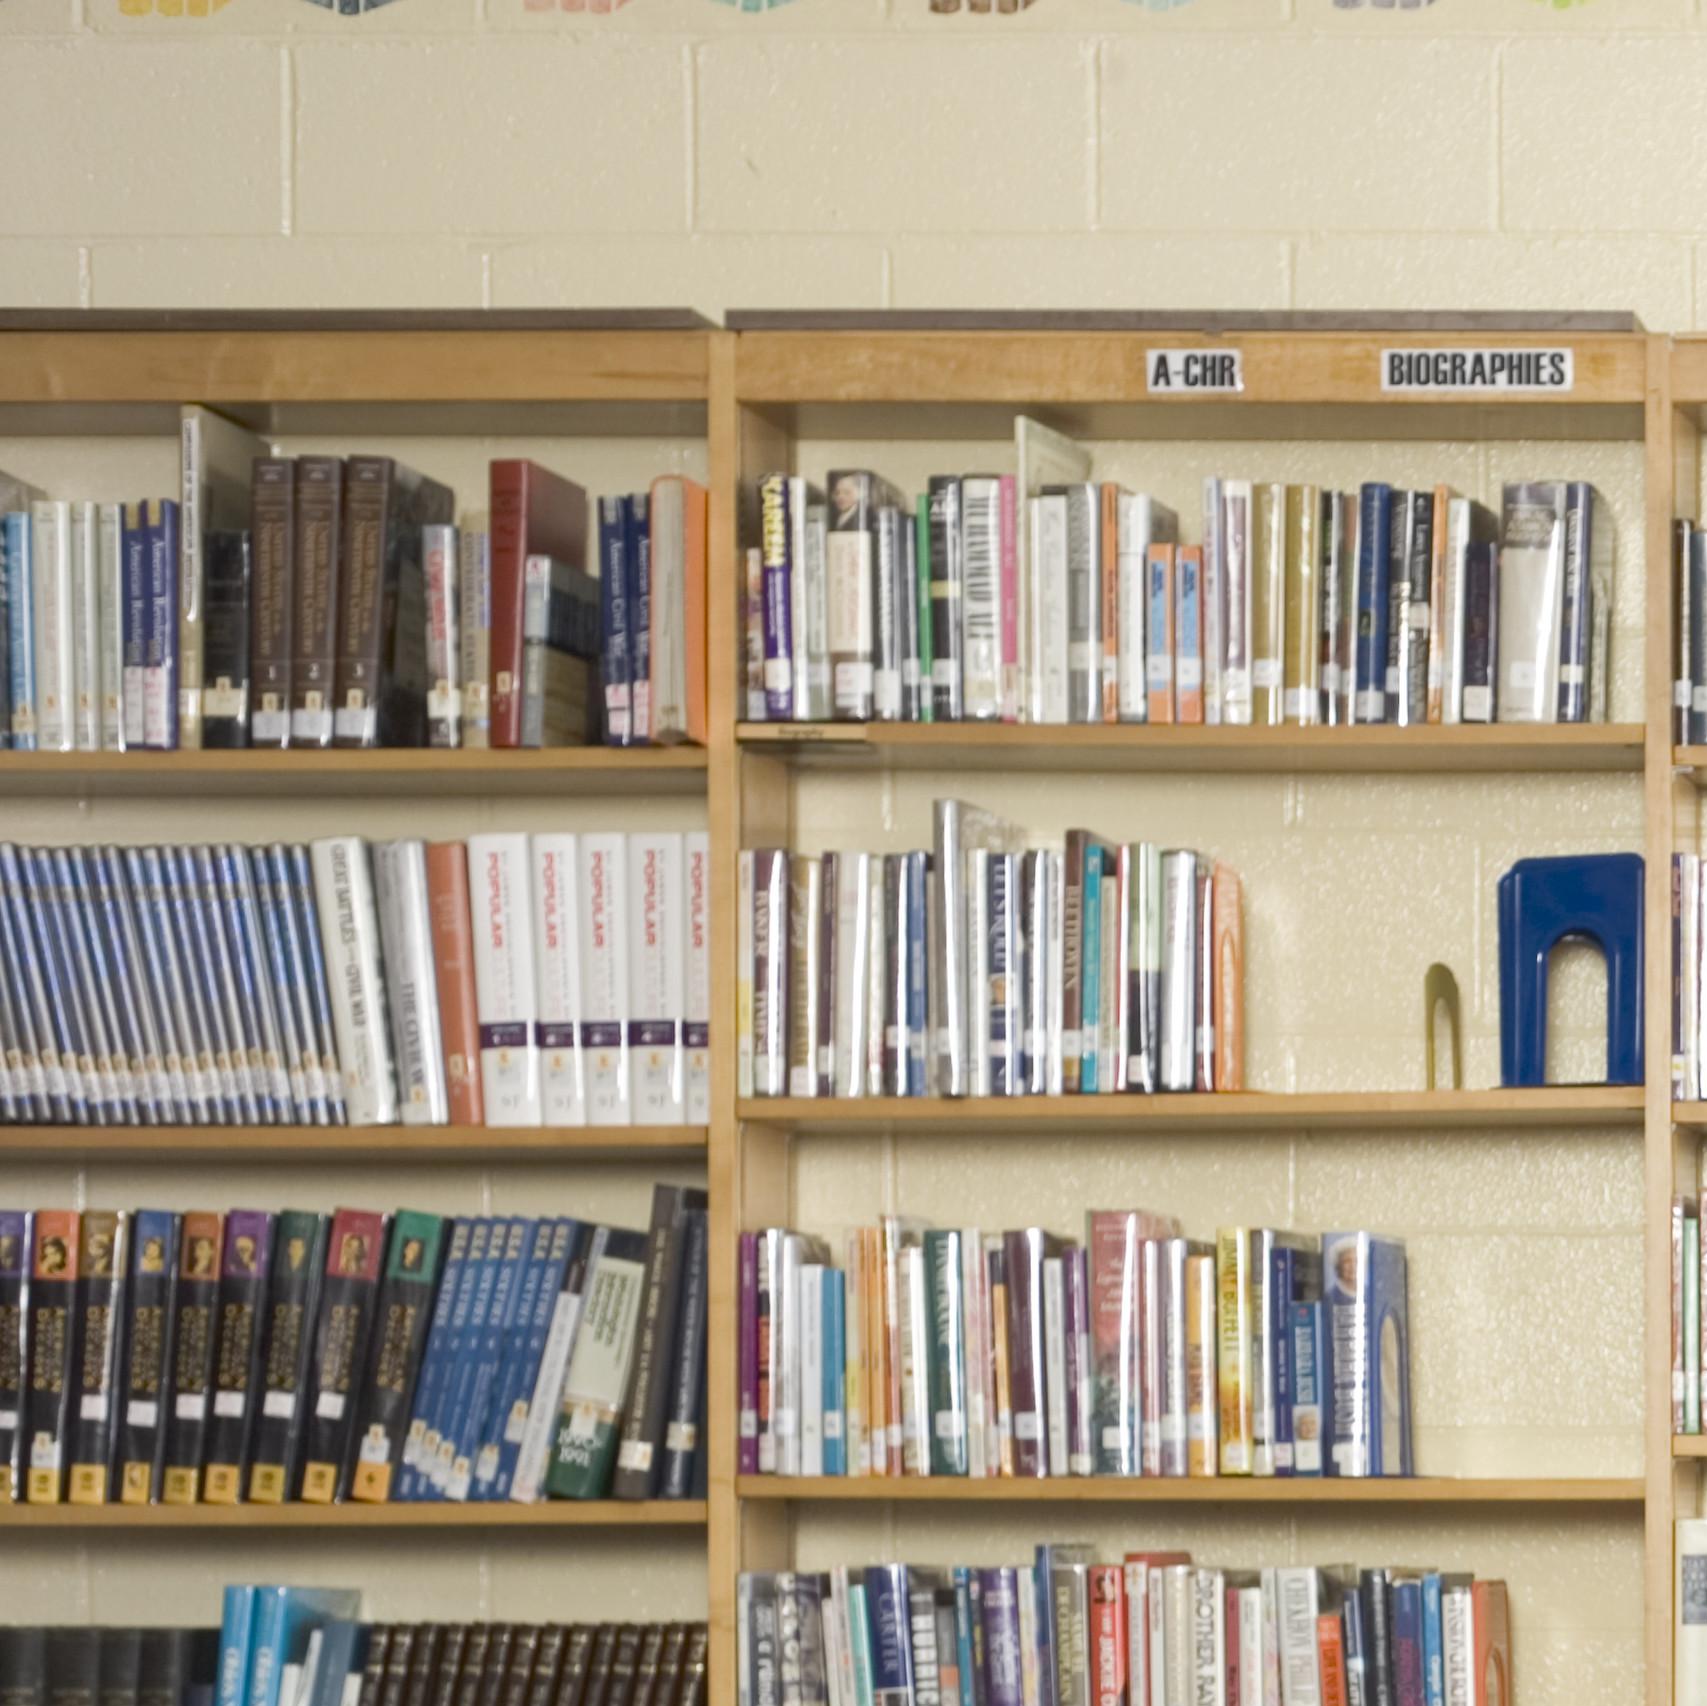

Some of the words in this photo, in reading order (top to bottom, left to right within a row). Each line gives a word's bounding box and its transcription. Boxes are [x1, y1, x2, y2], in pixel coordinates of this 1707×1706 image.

[1152, 354, 1236, 387] A-CHR
[1388, 352, 1566, 386] BIOGRAPHIES
[130, 541, 144, 596] American
[151, 537, 166, 592] American
[609, 538, 622, 595] American
[488, 852, 503, 949] POPULAR
[544, 852, 557, 949] POPULAR
[591, 851, 604, 949] POPULAR
[879, 1593, 898, 1672] CARTER
